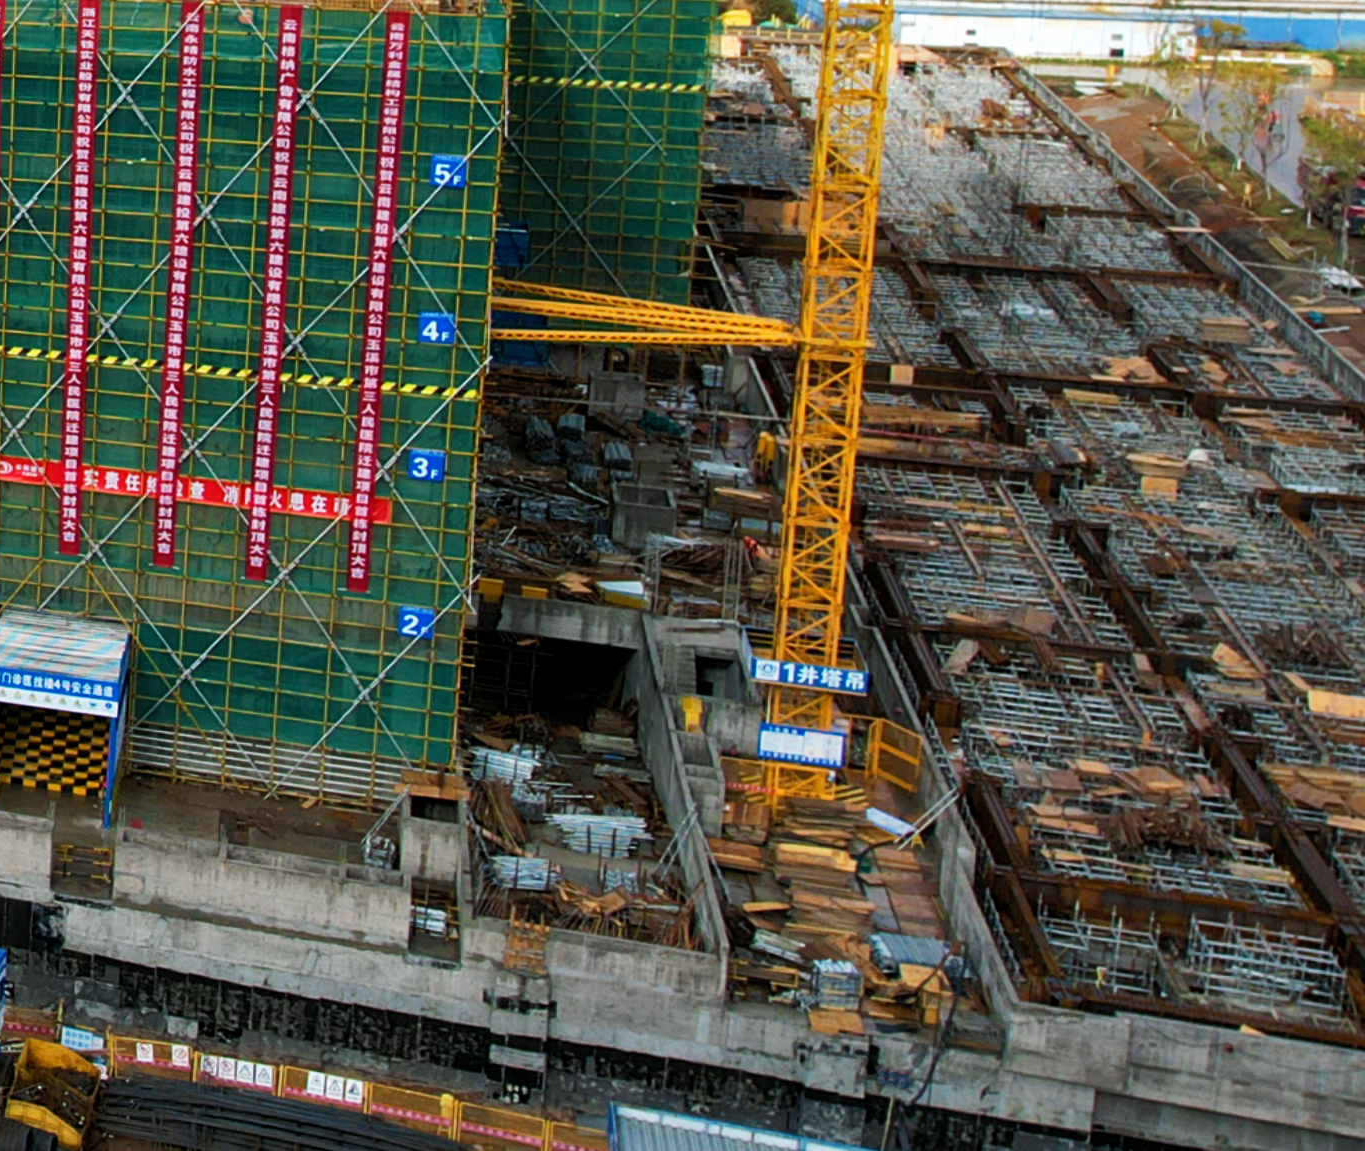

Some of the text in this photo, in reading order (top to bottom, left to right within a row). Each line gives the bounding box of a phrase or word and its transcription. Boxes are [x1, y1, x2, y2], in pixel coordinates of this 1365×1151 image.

[434, 163, 462, 185] 5F
[422, 320, 450, 342] 4F
[412, 456, 439, 479] 3F
[401, 613, 429, 636] 2F
